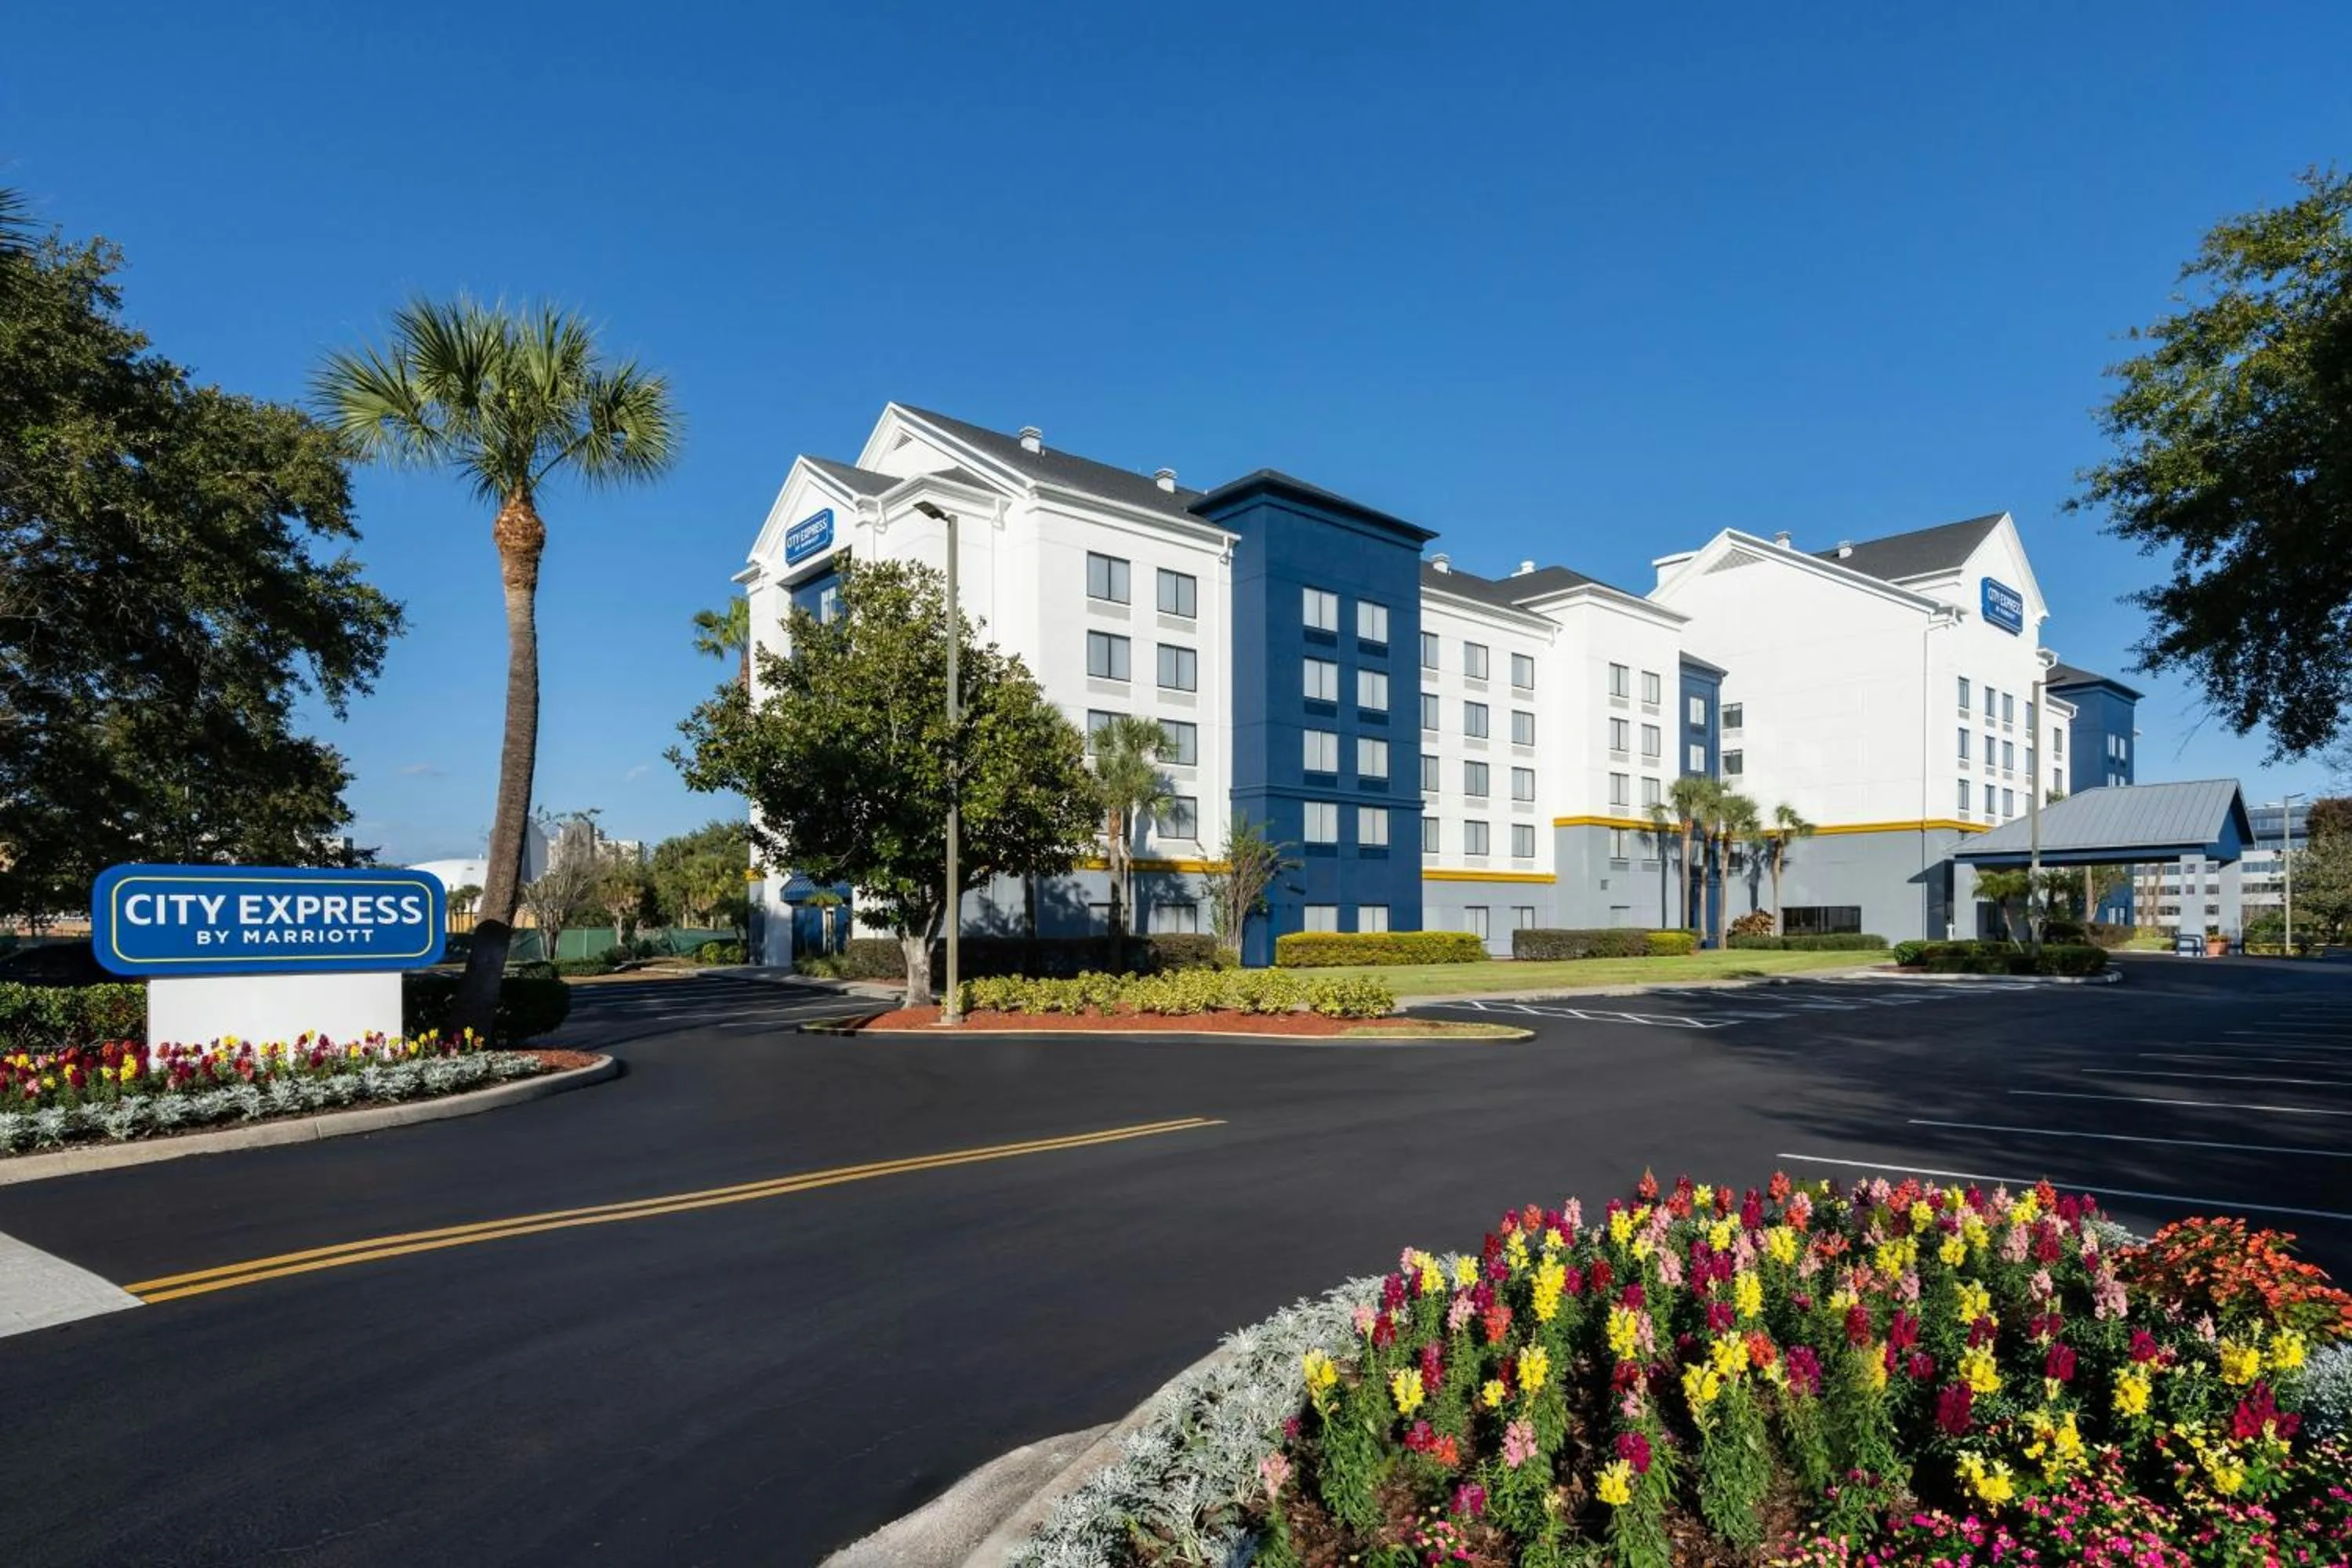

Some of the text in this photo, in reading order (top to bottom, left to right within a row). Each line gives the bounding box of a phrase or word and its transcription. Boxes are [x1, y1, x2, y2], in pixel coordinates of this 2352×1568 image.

[125, 894, 422, 925] CITY EXPRESS
[197, 929, 373, 945] BY MARRIOTT
